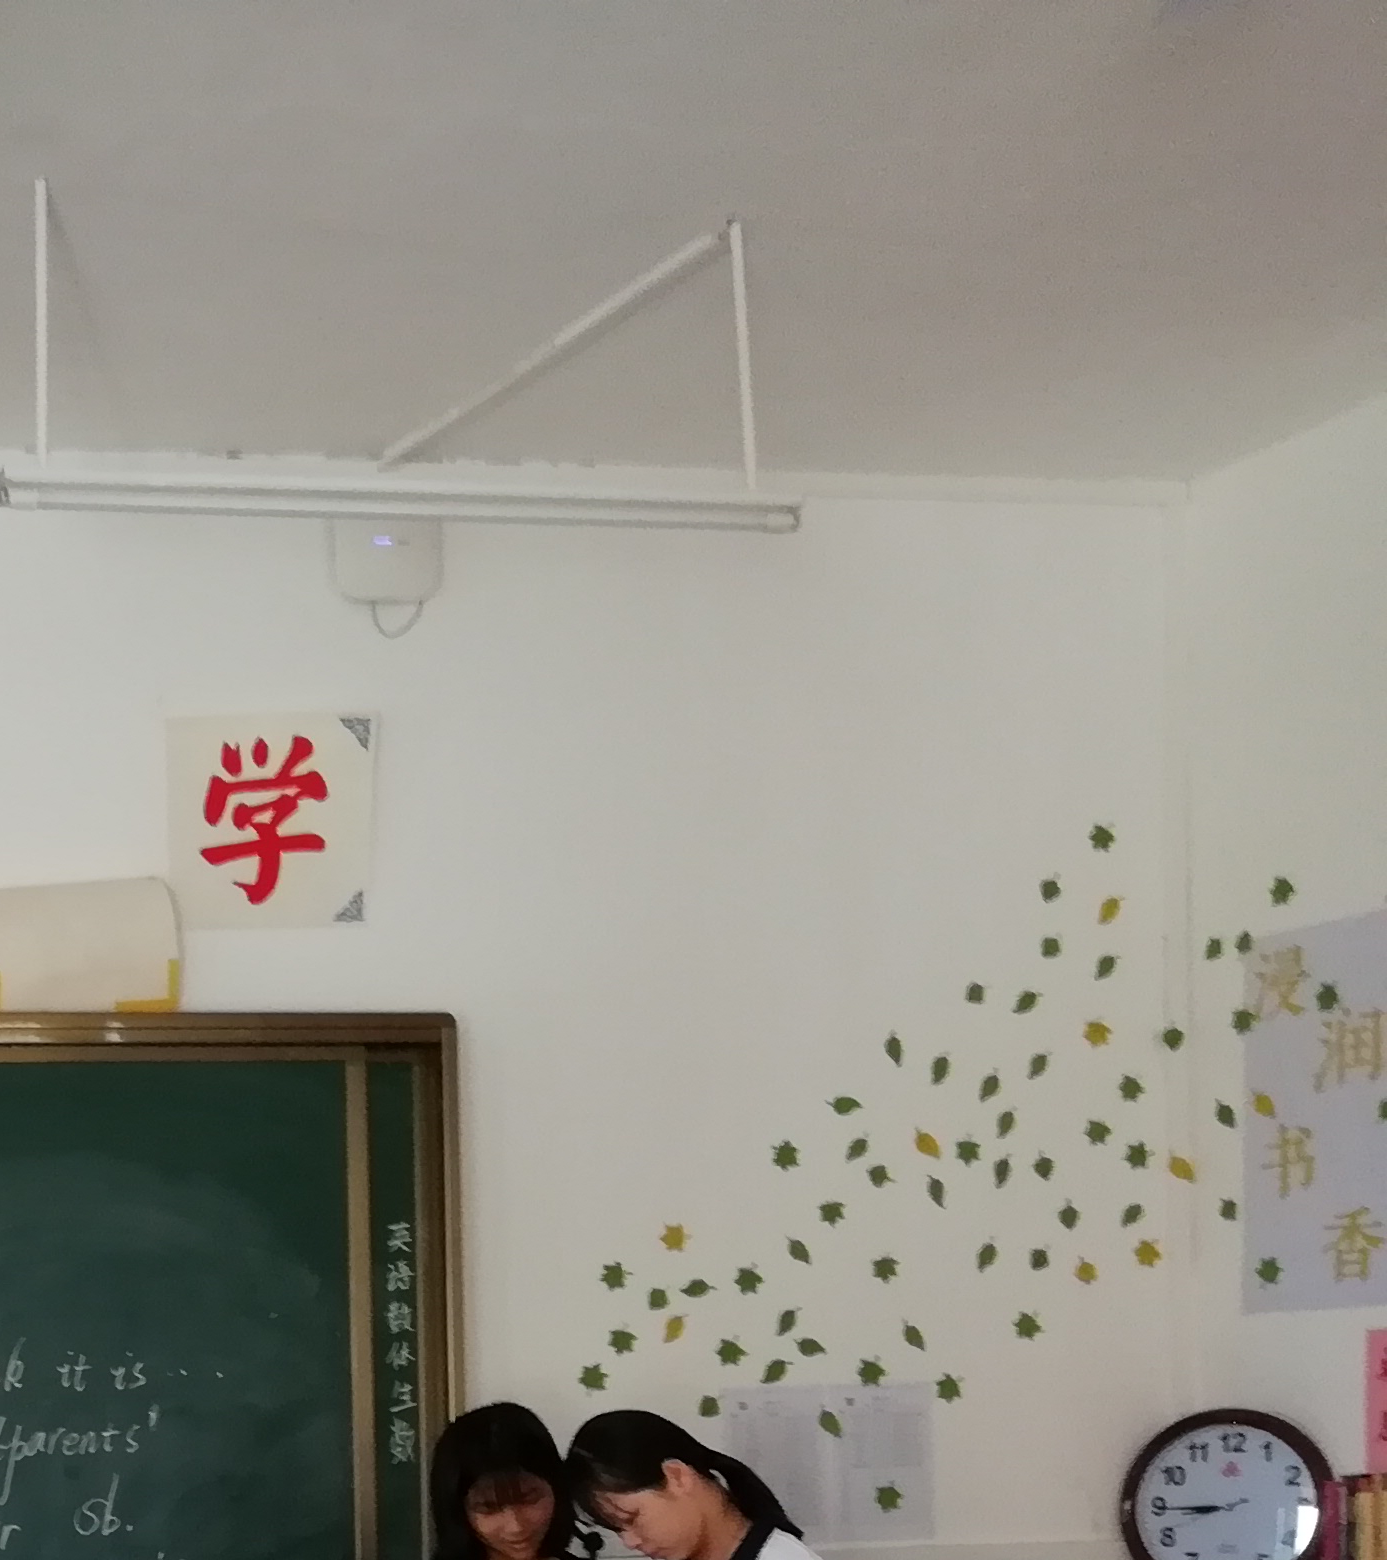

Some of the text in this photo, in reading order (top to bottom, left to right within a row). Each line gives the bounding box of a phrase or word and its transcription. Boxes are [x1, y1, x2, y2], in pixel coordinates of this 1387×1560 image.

[201, 737, 327, 904] 学
[56, 1351, 93, 1391] it
[1189, 1442, 1209, 1462] 11
[1220, 1432, 1248, 1453] 12
[1261, 1441, 1273, 1462] 1
[1162, 1465, 1187, 1486] 10
[1284, 1465, 1302, 1487] 2
[1151, 1496, 1168, 1517] 9
[1159, 1527, 1177, 1548] 8
